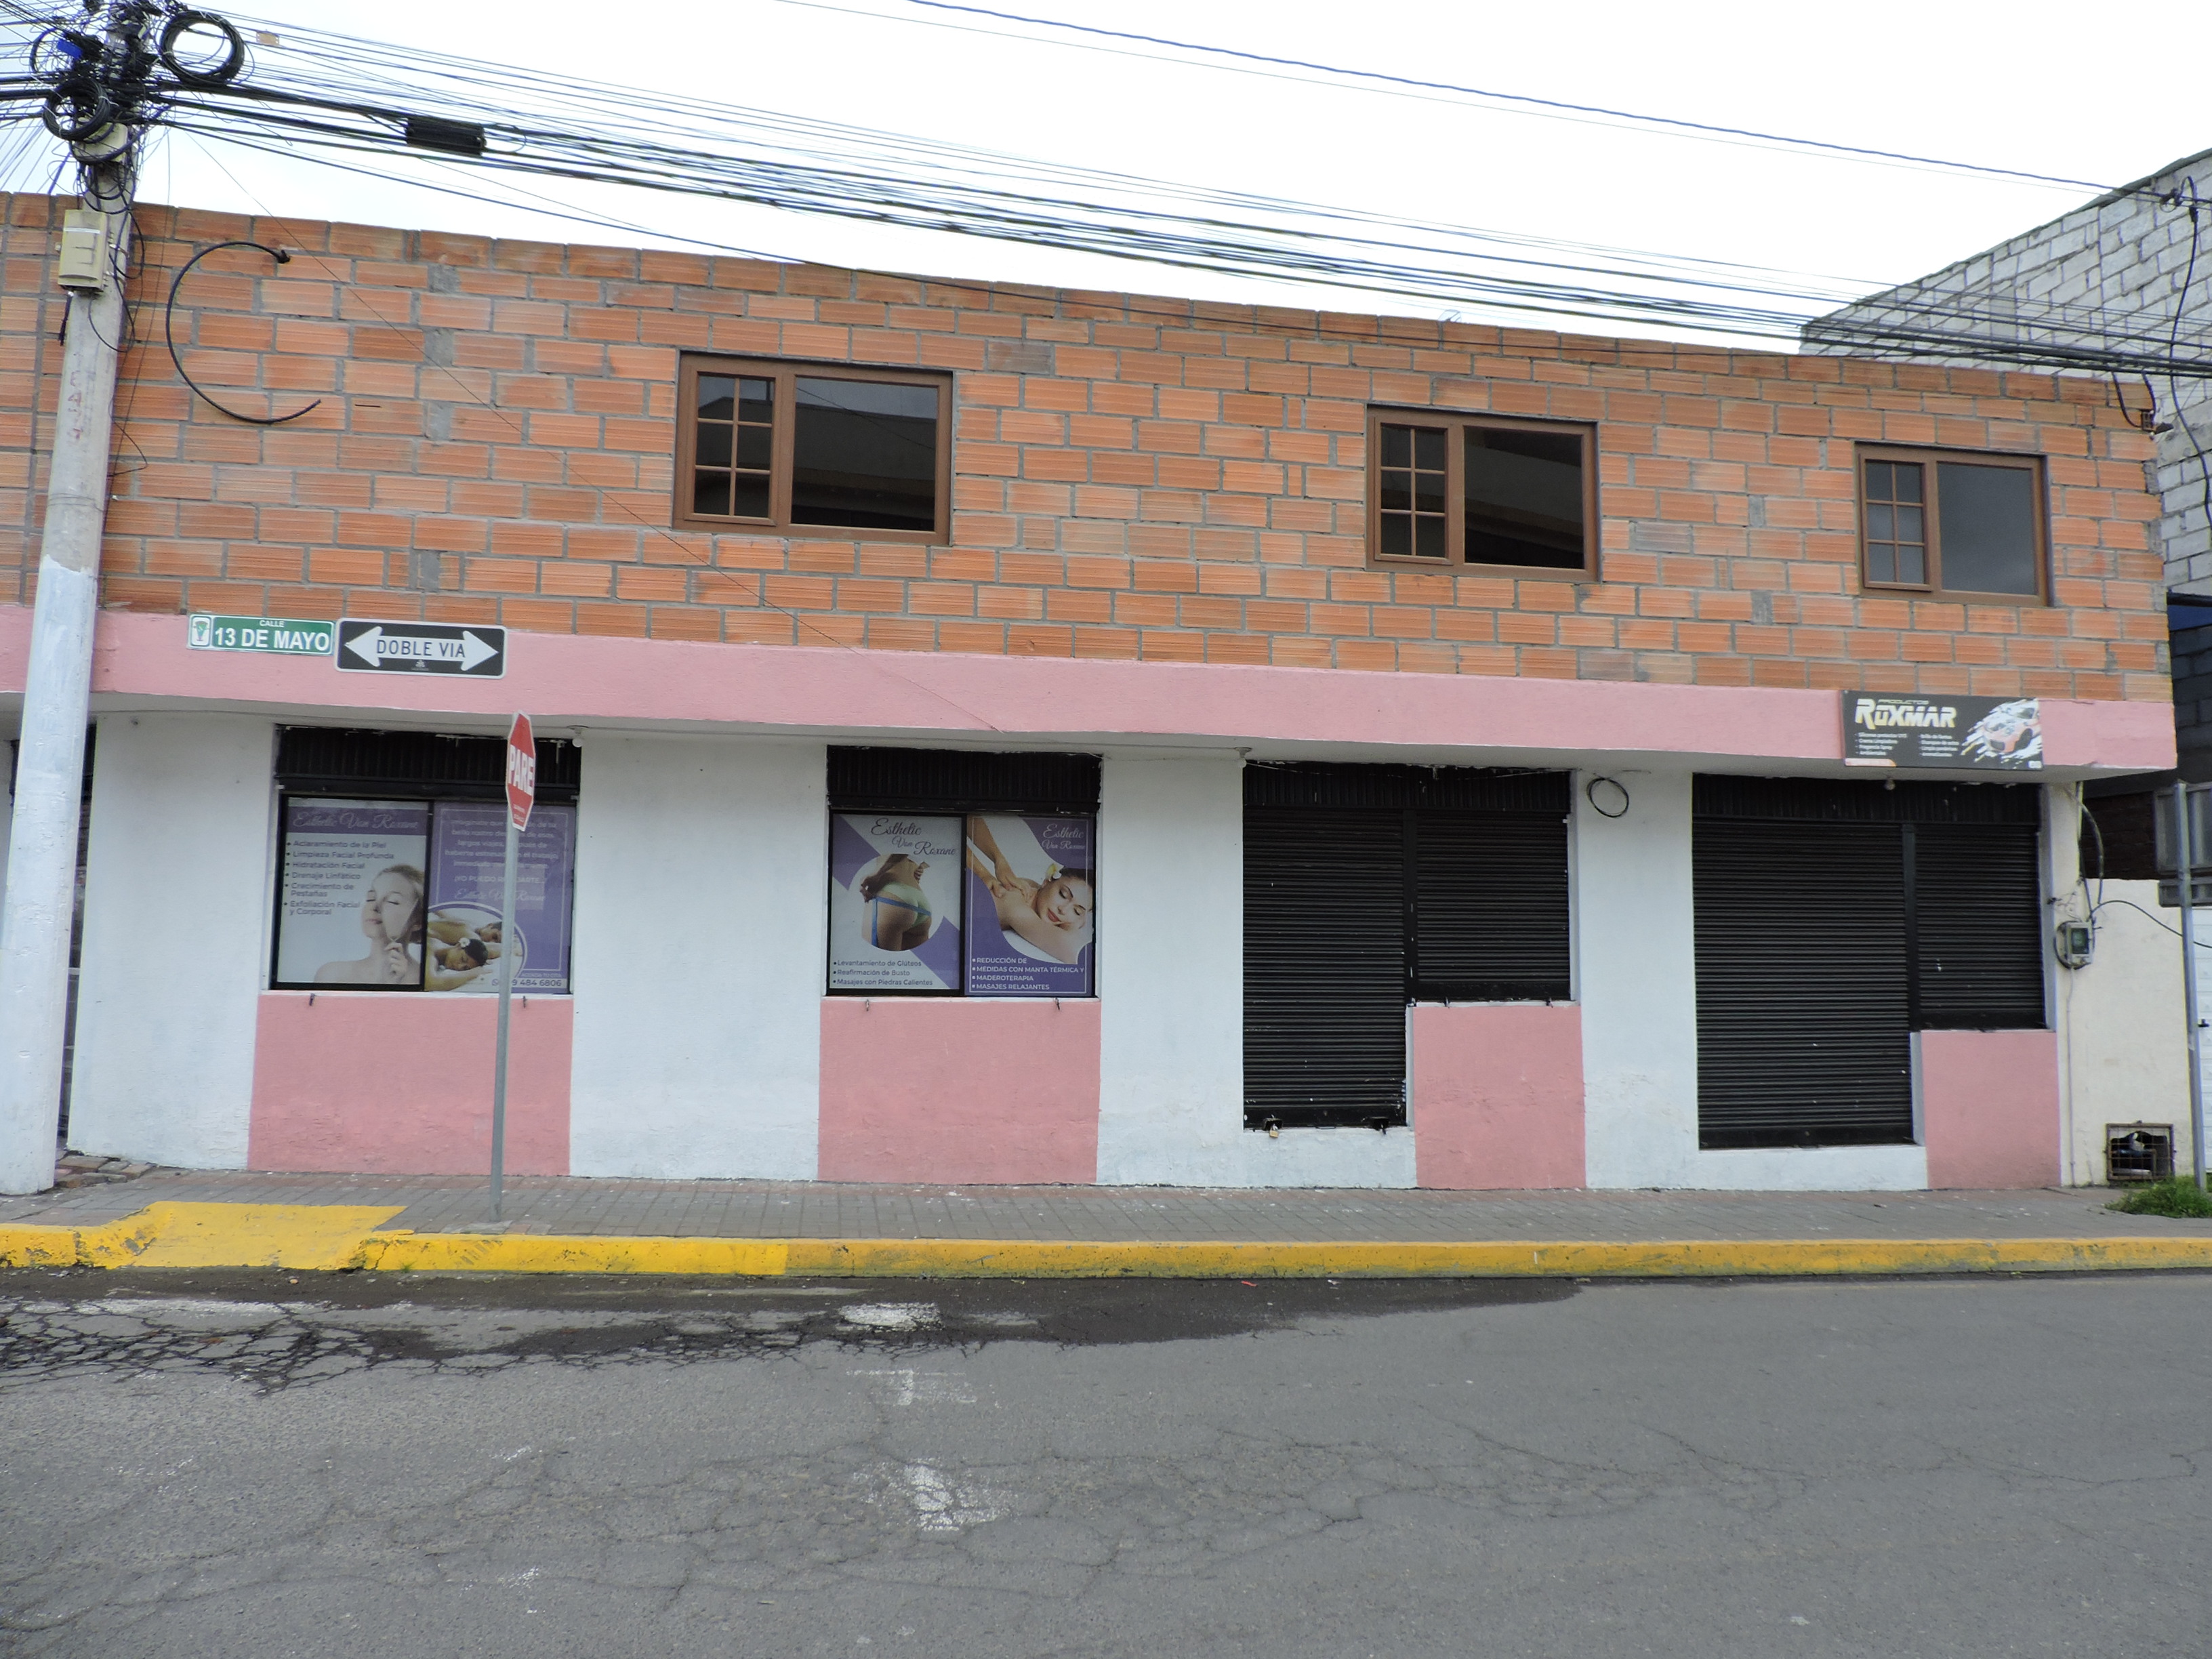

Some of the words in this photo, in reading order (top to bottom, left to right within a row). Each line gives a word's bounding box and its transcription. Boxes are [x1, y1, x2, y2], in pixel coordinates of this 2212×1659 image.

[215, 628, 235, 647] 13
[241, 628, 268, 648] DE
[274, 630, 329, 651] MAYO
[377, 640, 432, 656] DOBLE
[439, 642, 466, 658] VIA
[508, 744, 534, 797] PARE
[871, 817, 922, 836] Esthetic
[293, 851, 329, 859] Limpieza
[914, 841, 957, 855] Roxane
[290, 900, 335, 908] Exfoliación
